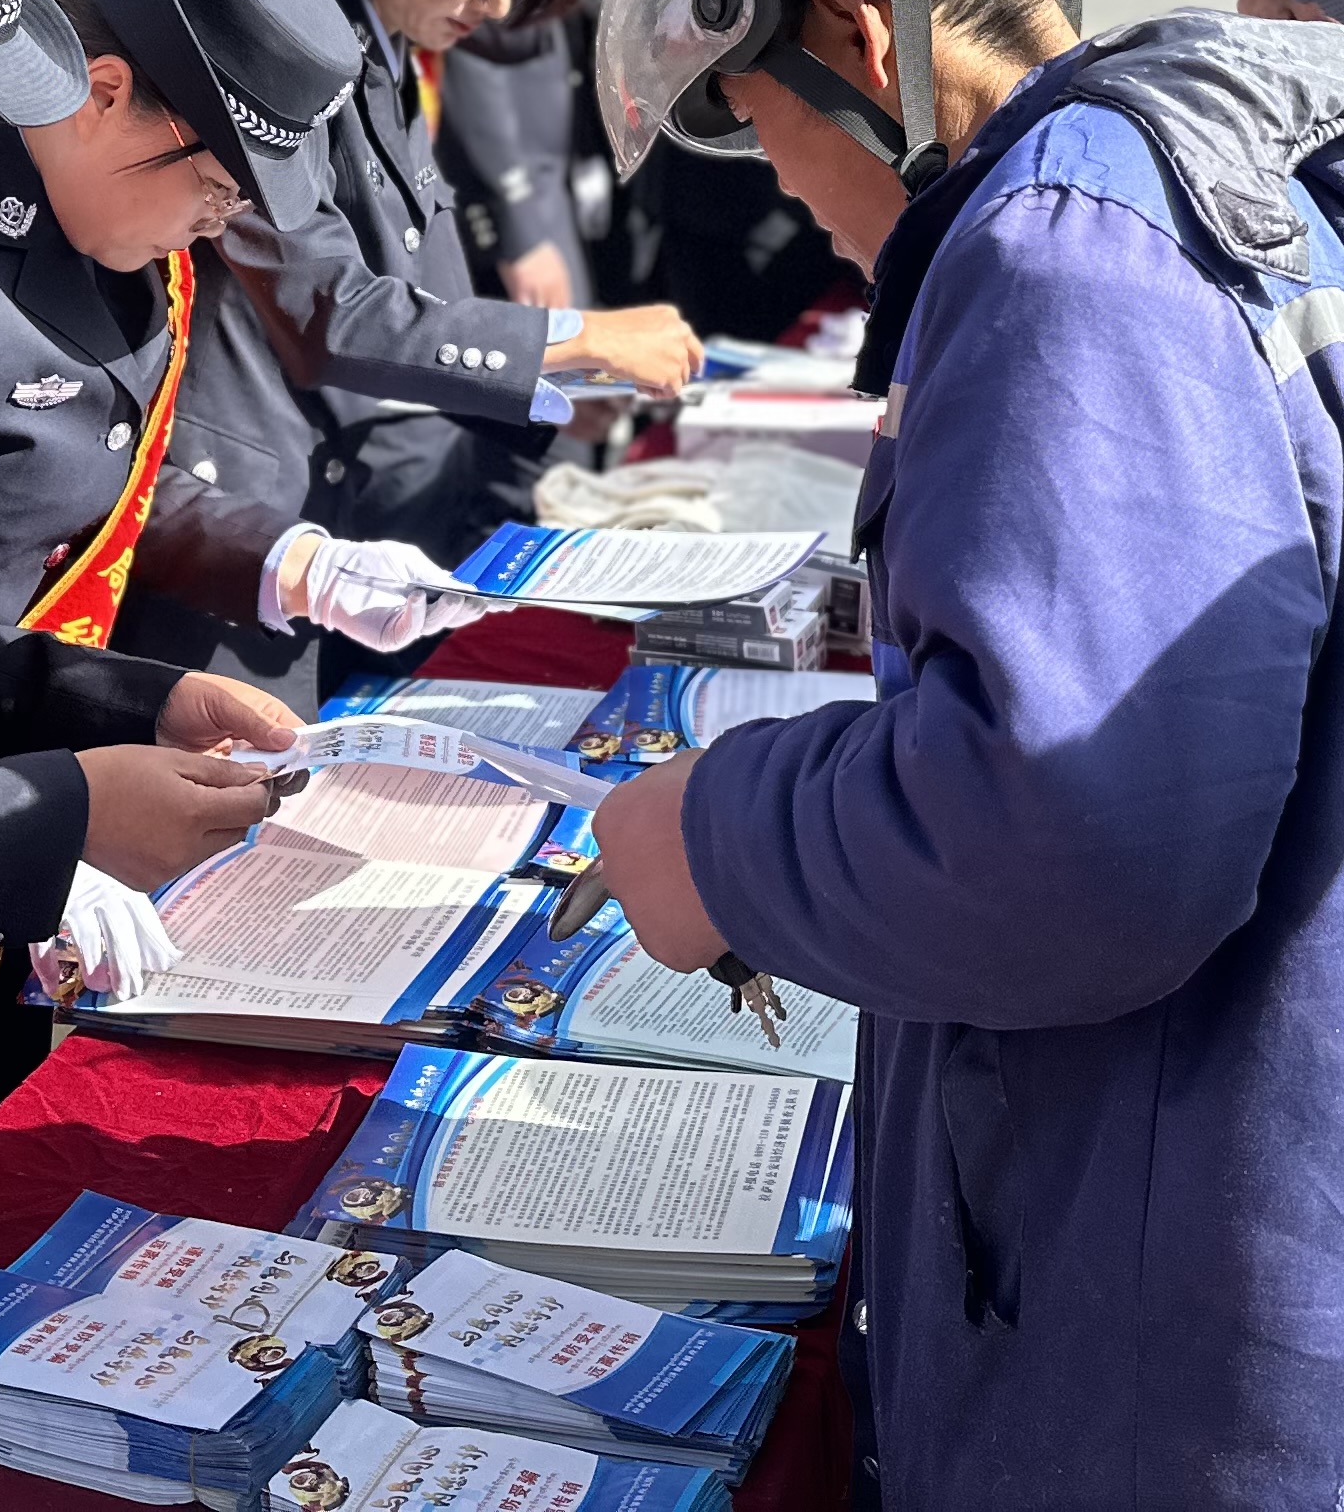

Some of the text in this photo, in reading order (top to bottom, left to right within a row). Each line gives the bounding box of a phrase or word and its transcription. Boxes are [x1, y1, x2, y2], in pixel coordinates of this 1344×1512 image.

[118, 1238, 169, 1282] 远离传销
[153, 1245, 205, 1289] 谨防受骗
[11, 1313, 70, 1357] 远离传销
[448, 1291, 524, 1348] 与民同心
[46, 1320, 108, 1365] 谨防受骗
[134, 1329, 211, 1390] 与民同心
[548, 1321, 607, 1367] 谨防受骗
[584, 1332, 642, 1379] 远离传销
[494, 1469, 543, 1512] 防受骗
